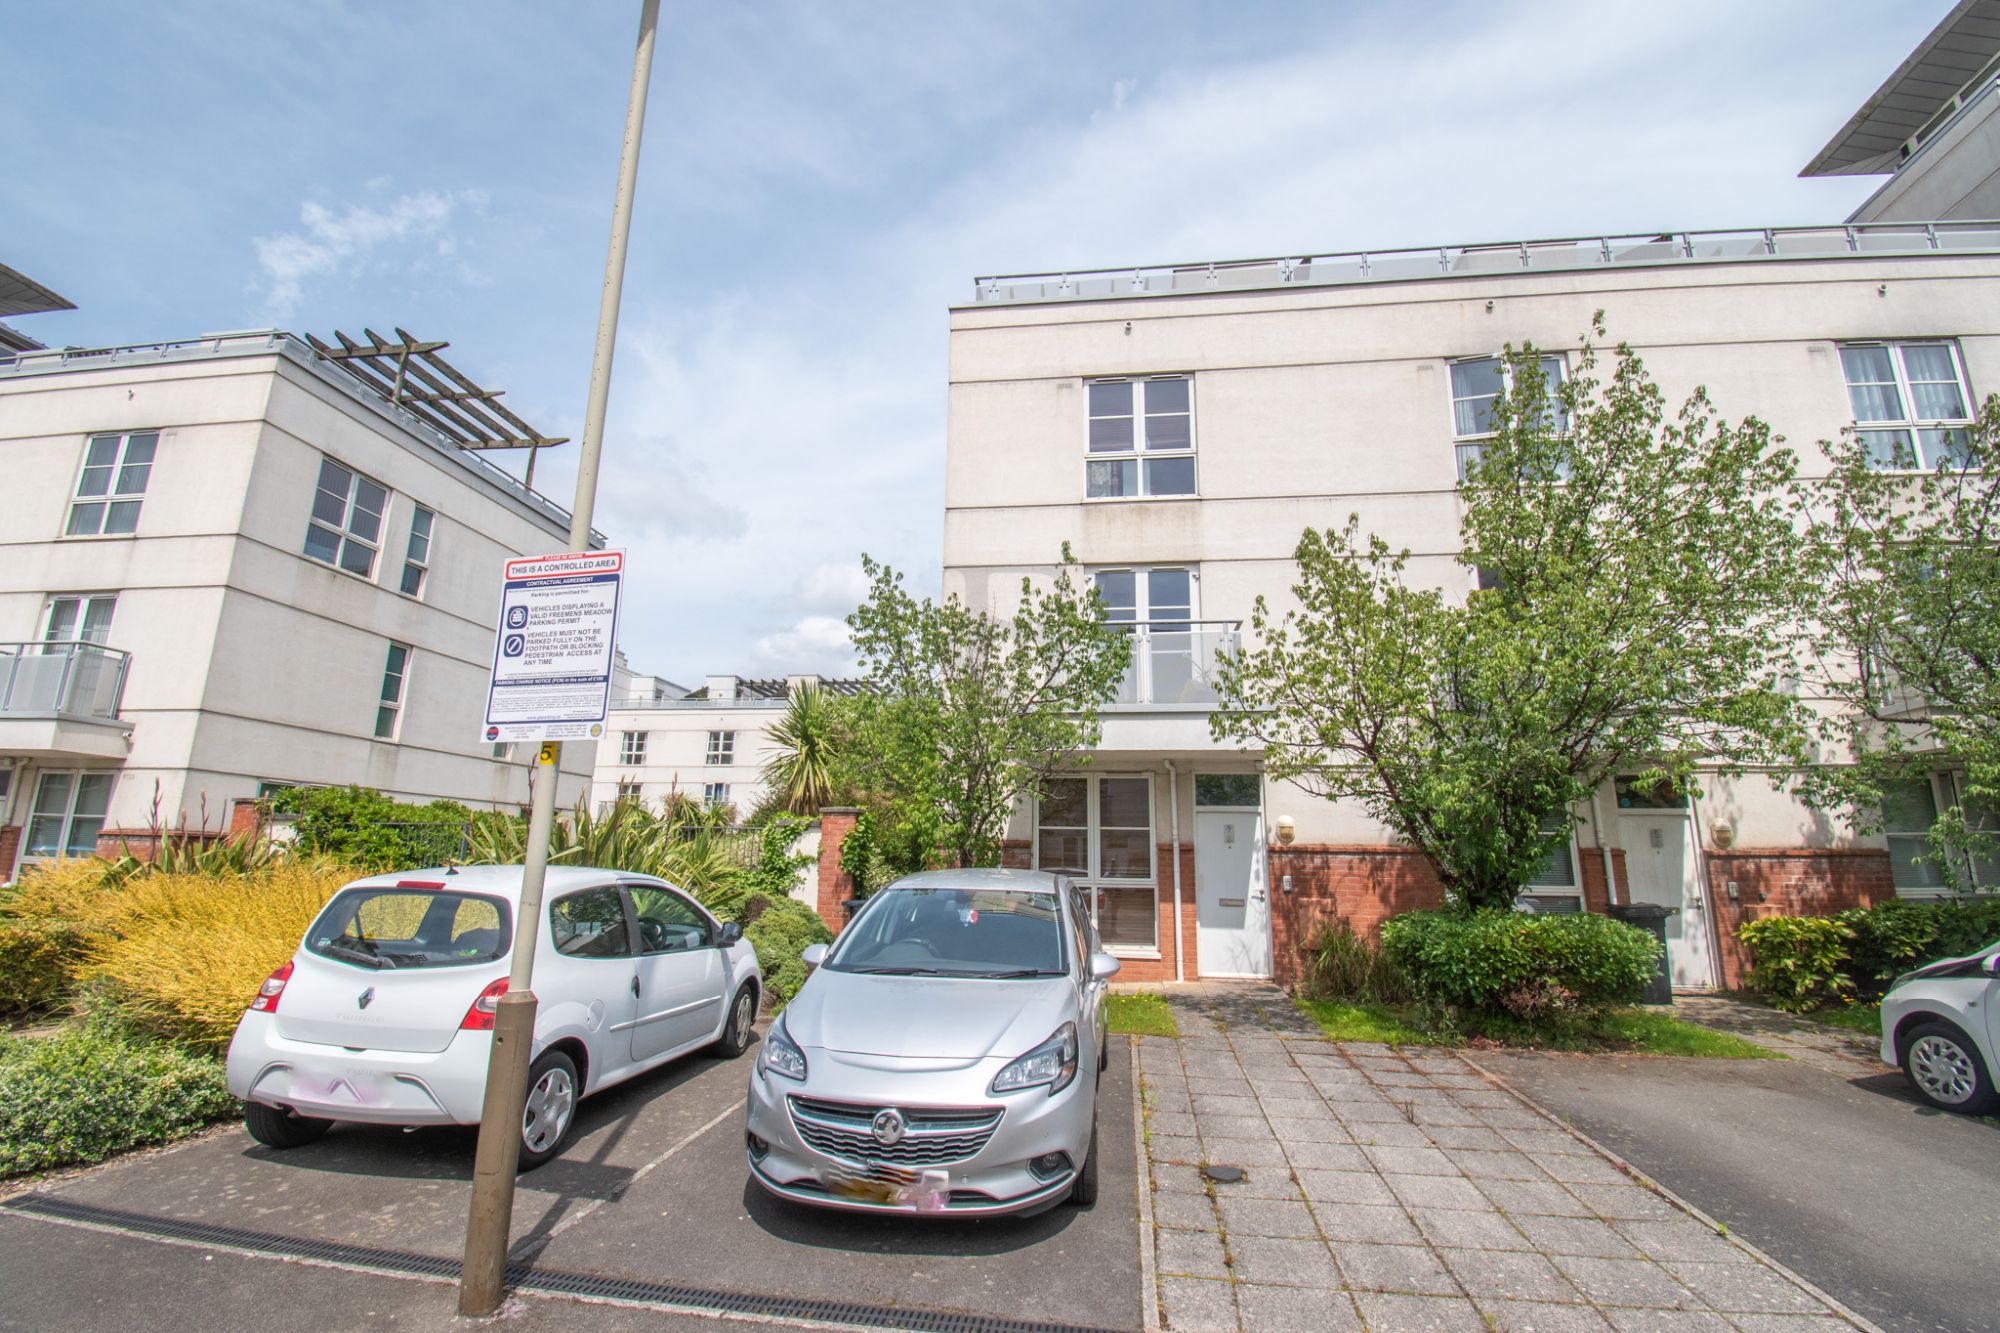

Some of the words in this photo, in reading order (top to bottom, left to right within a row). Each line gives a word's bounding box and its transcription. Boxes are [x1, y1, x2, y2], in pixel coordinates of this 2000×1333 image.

[511, 566, 527, 574] THIS
[529, 565, 536, 573] IS
[544, 560, 594, 572] CONTROLLED
[595, 559, 616, 568] AREA
[526, 579, 562, 587] CONTRACTUAL
[563, 576, 594, 584] AGREEMENT
[562, 602, 598, 611] DISPLAYING
[549, 610, 582, 618] FREEMENS
[584, 608, 612, 616] MEADOW
[527, 630, 557, 638] VEHICLES
[570, 642, 603, 650] BLOCKING
[525, 651, 564, 659] PEDESTRIAN
[541, 745, 552, 760] 5
